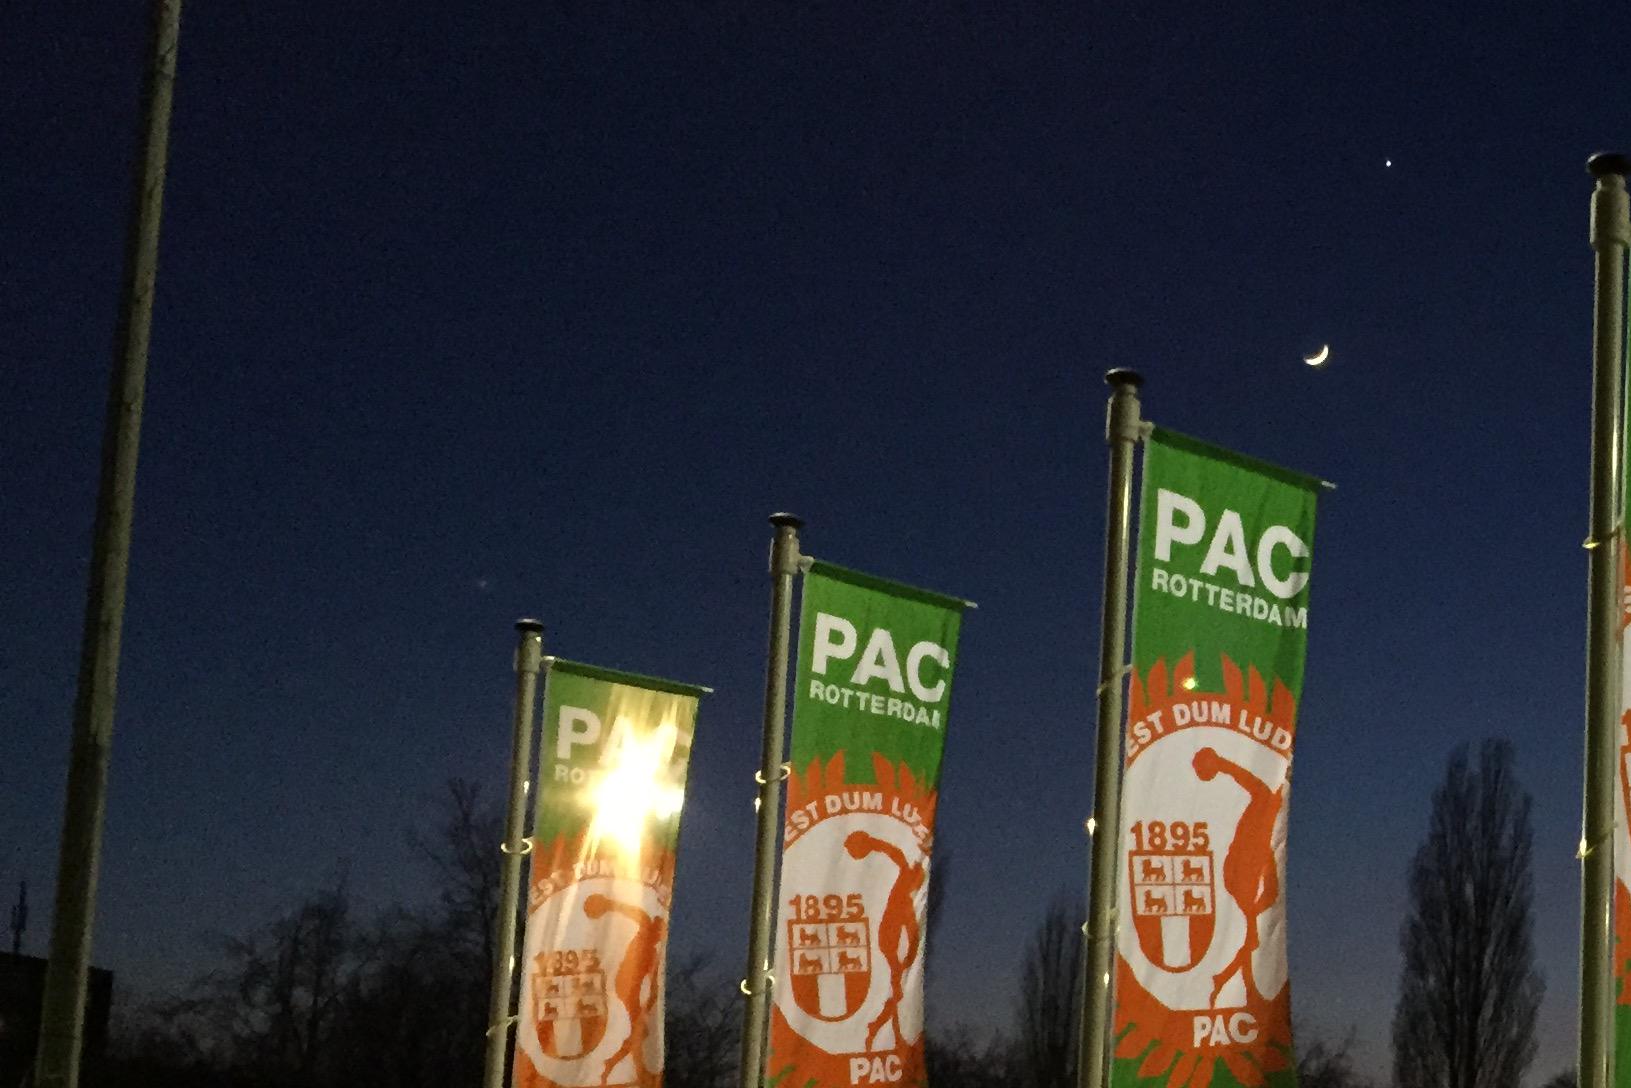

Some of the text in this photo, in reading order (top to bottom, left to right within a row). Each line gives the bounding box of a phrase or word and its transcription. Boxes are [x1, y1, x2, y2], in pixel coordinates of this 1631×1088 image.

[1155, 487, 1310, 599] PAC
[1152, 567, 1308, 629] ROTTERDAM
[812, 611, 950, 703] PAC
[1172, 700, 1231, 727] DUM
[824, 791, 884, 815] DUM
[1130, 820, 1210, 850] 1895
[789, 893, 865, 920] 1895
[1193, 1012, 1259, 1048] PAC
[849, 1054, 903, 1085] PAC
